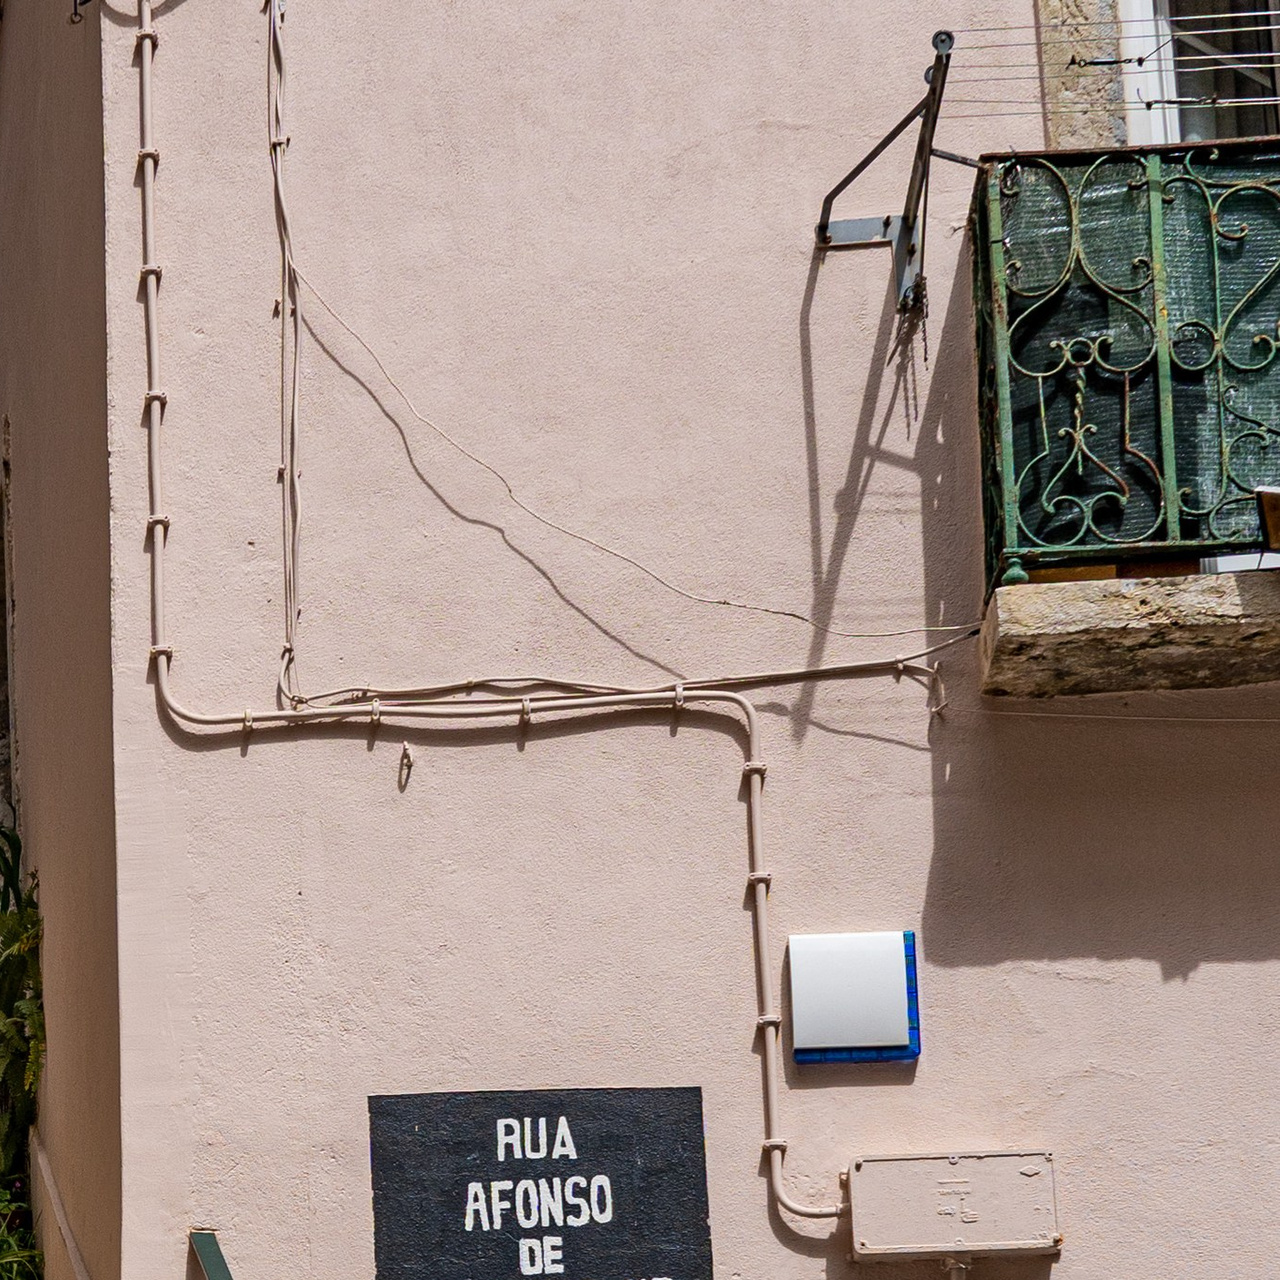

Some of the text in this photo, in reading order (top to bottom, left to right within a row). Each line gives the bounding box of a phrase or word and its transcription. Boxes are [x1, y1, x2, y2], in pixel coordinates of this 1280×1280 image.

[496, 1116, 578, 1161] RUA
[465, 1175, 613, 1231] AFONSO
[520, 1236, 564, 1276] DE
